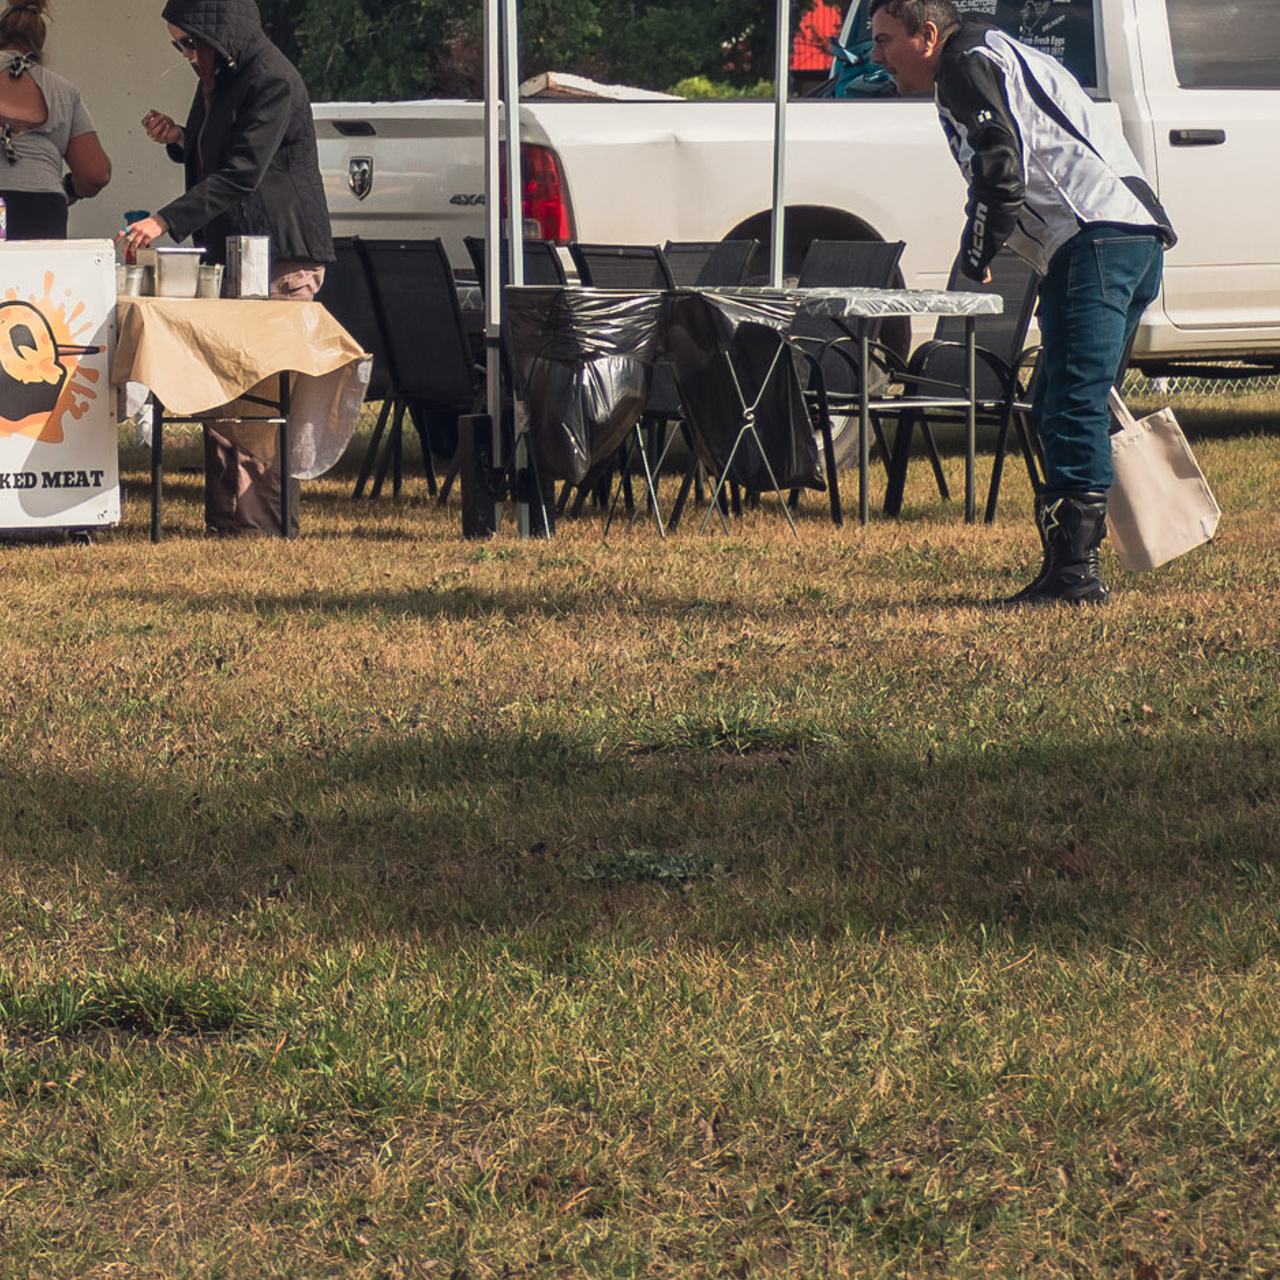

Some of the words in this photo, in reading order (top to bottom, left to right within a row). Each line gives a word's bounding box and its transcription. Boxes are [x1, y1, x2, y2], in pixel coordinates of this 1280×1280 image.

[1034, 35, 1050, 45] Fresh
[1051, 35, 1065, 47] Eggs
[967, 202, 989, 268] icon
[41, 470, 105, 489] MEAT
